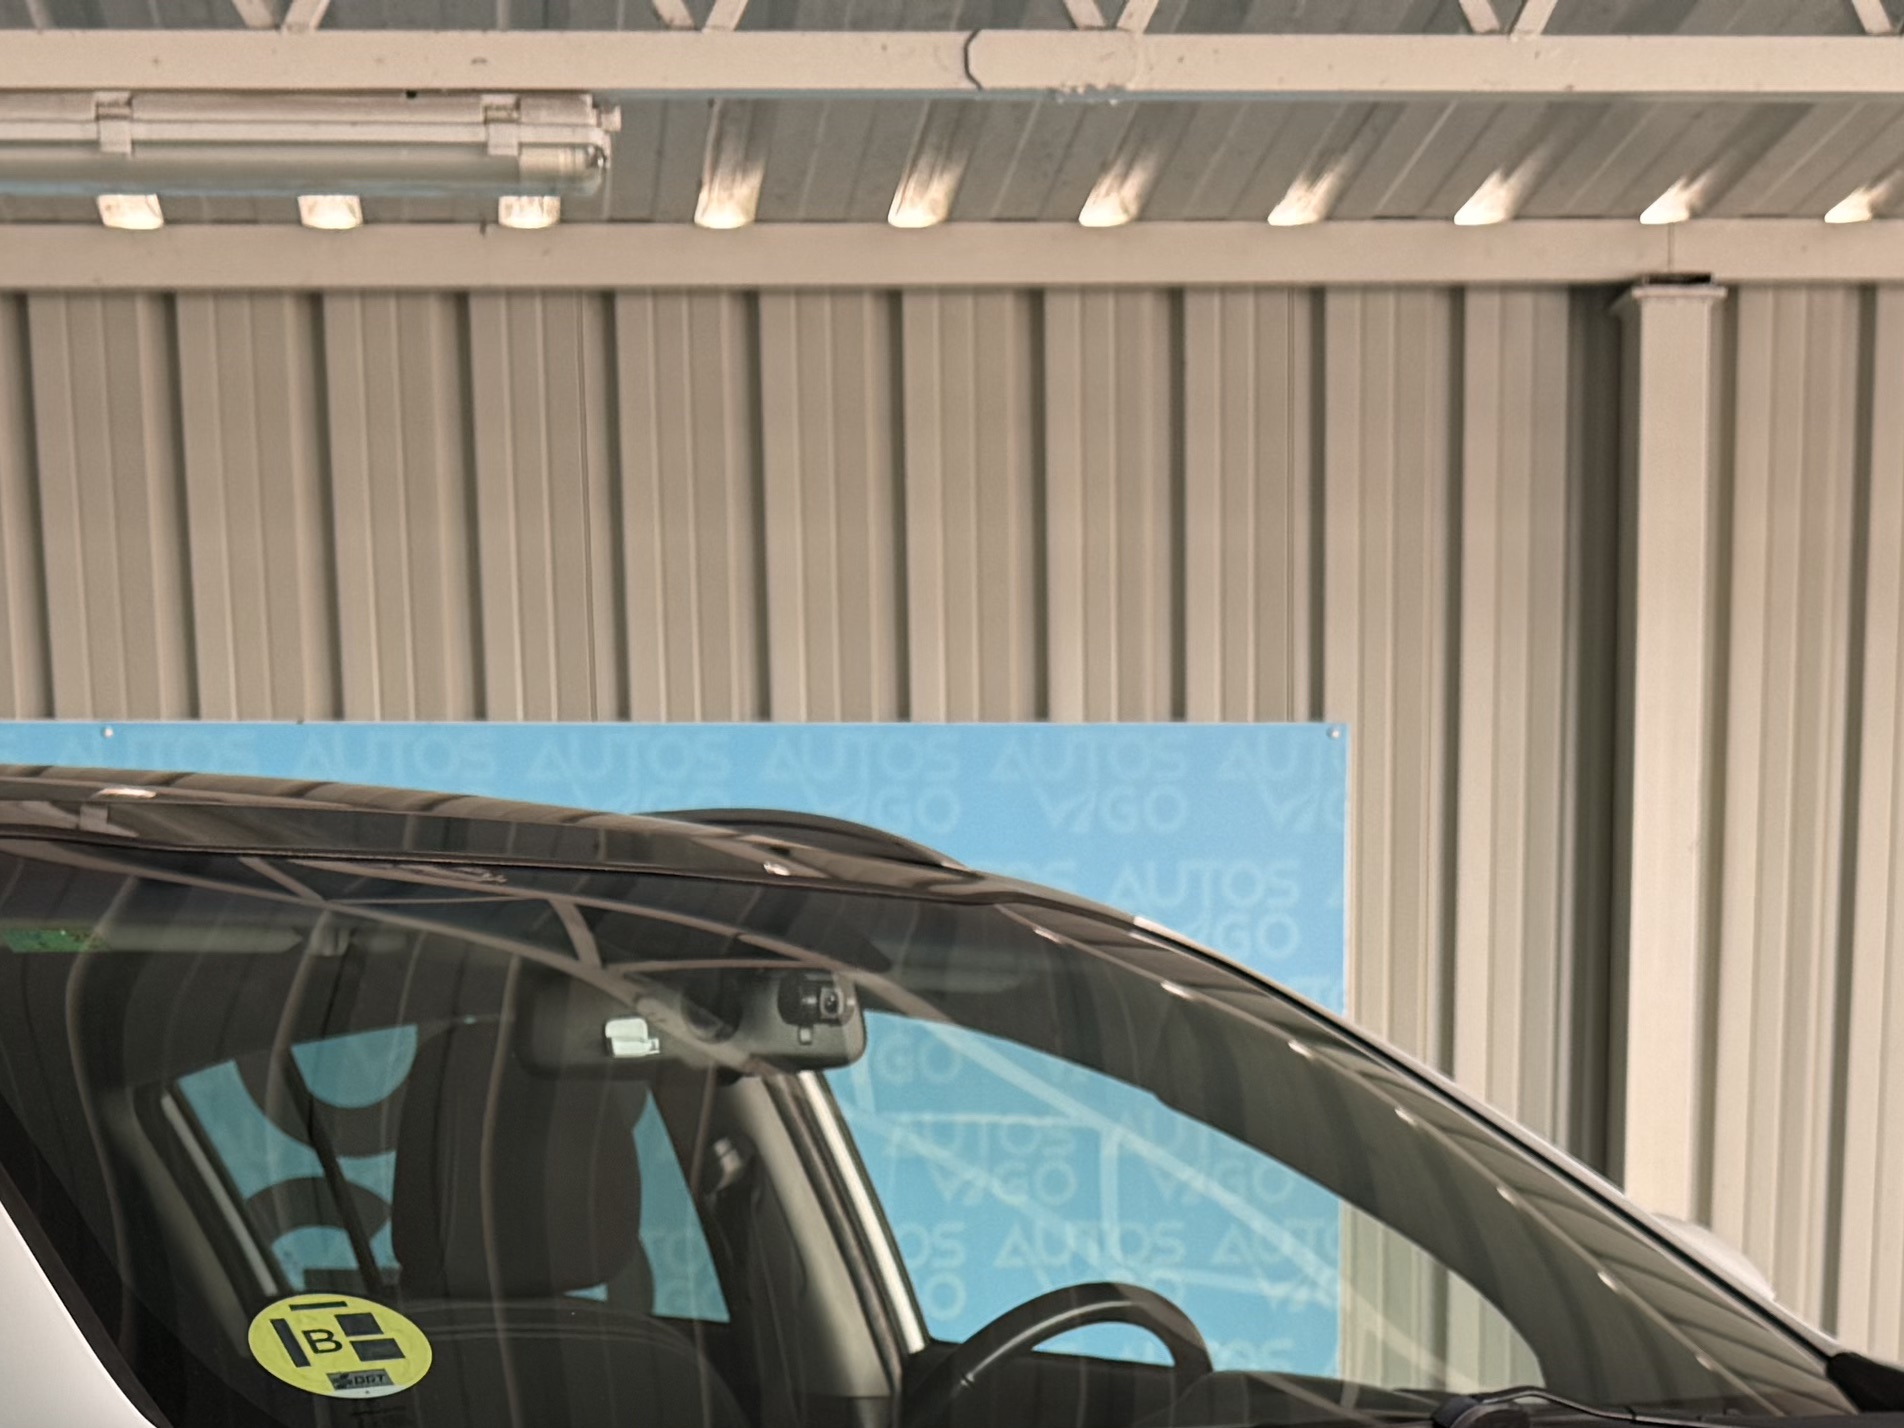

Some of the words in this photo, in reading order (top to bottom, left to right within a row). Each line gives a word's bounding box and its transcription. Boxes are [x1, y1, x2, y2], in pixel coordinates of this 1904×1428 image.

[292, 730, 497, 782] AUTOS
[525, 732, 731, 781] AUTOS
[755, 732, 962, 781] AUTOS
[989, 732, 1188, 781] AUTOS
[1031, 784, 1188, 835] VIGO
[1110, 859, 1300, 910] AUTOS
[302, 1328, 344, 1354] B
